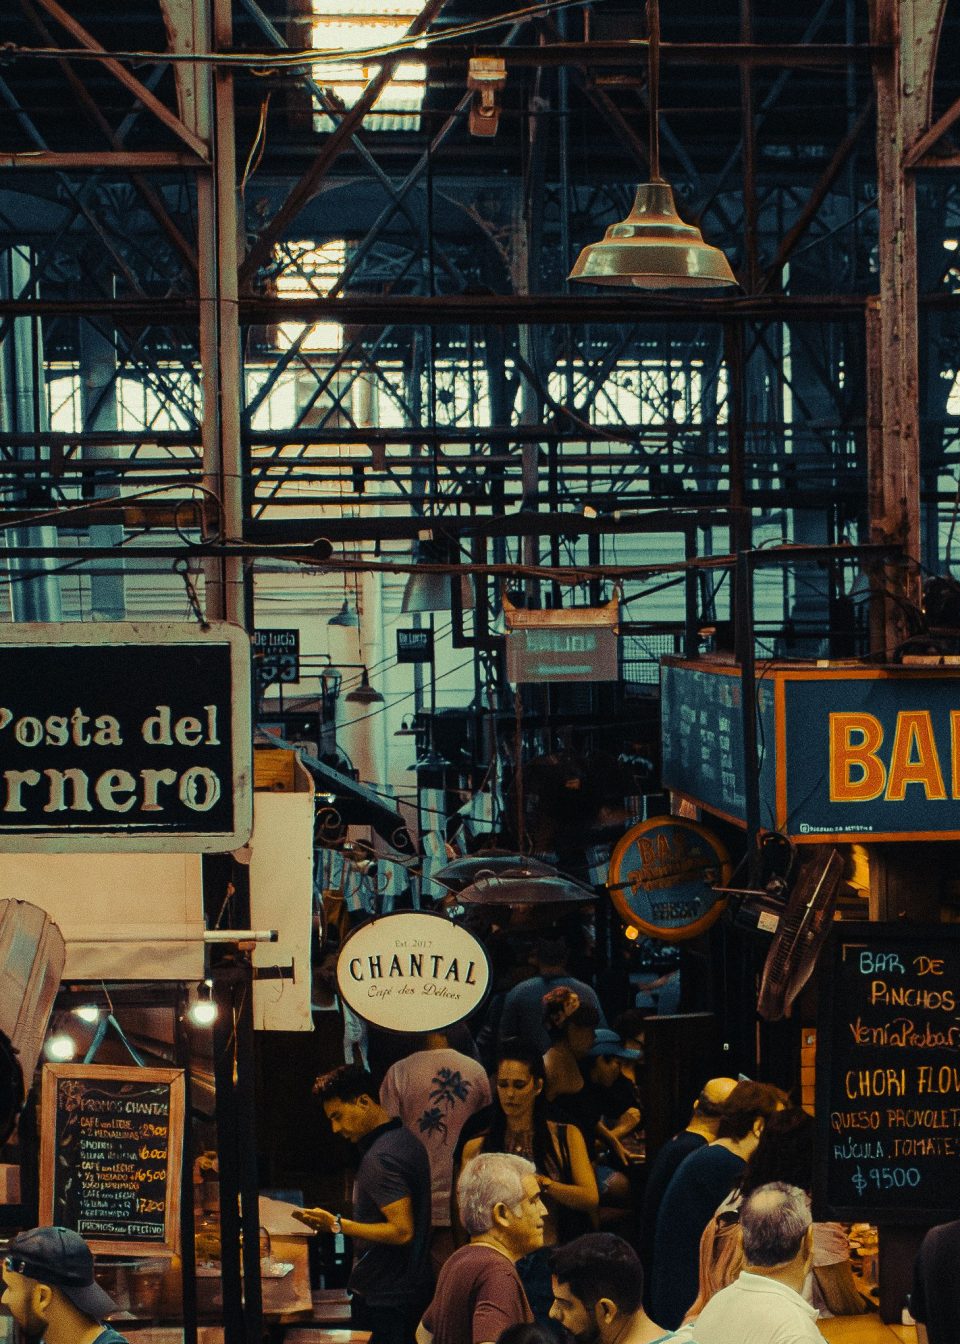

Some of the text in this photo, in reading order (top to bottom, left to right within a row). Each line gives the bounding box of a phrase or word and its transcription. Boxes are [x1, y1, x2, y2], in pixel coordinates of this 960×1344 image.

[141, 704, 221, 746] del
[3, 766, 221, 812] rnero
[349, 953, 477, 985] CHANTAL
[859, 951, 945, 977] BAR DE
[398, 983, 415, 994] des
[870, 980, 957, 1013] PINCHOS
[845, 1068, 906, 1100] CHORI
[830, 1110, 880, 1135] QUESO
[851, 1164, 921, 1197] $9500
